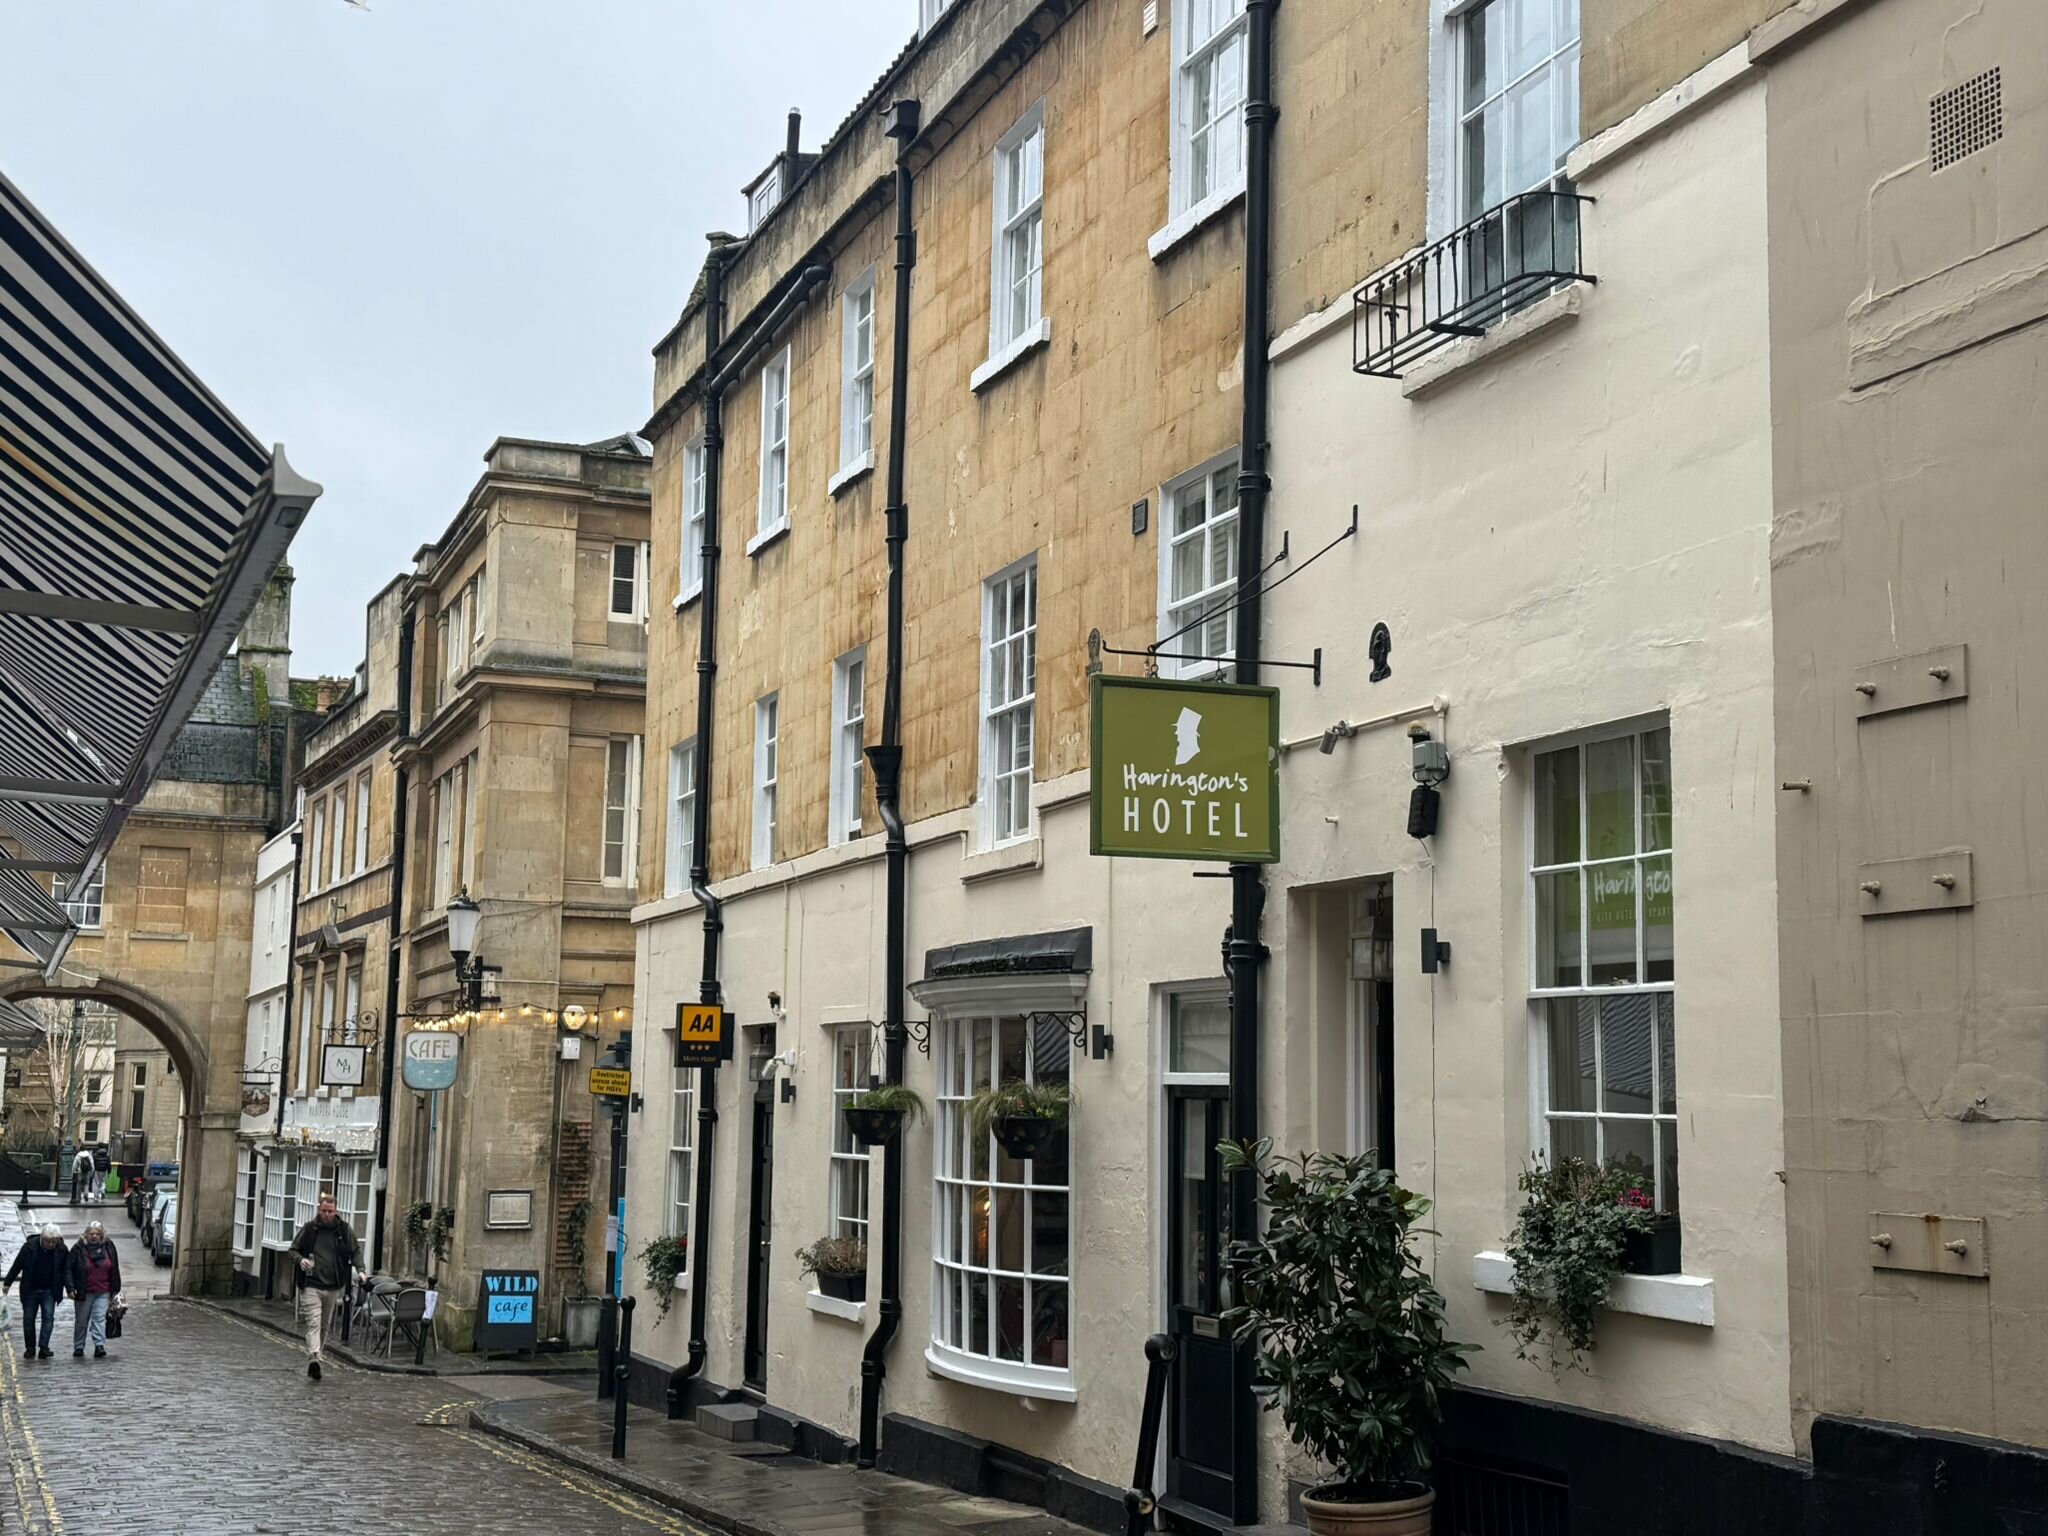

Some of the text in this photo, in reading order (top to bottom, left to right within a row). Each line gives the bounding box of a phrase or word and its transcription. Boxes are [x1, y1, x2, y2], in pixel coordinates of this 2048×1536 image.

[1123, 763, 1249, 797] Harington's
[1123, 796, 1249, 838] HOTEL
[1616, 909, 1634, 921] HOTE
[689, 1014, 714, 1032] AA
[409, 1039, 451, 1059] CAFE
[596, 1071, 625, 1079] Restricted
[485, 1276, 538, 1292] WILD
[495, 1301, 528, 1321] cafe
